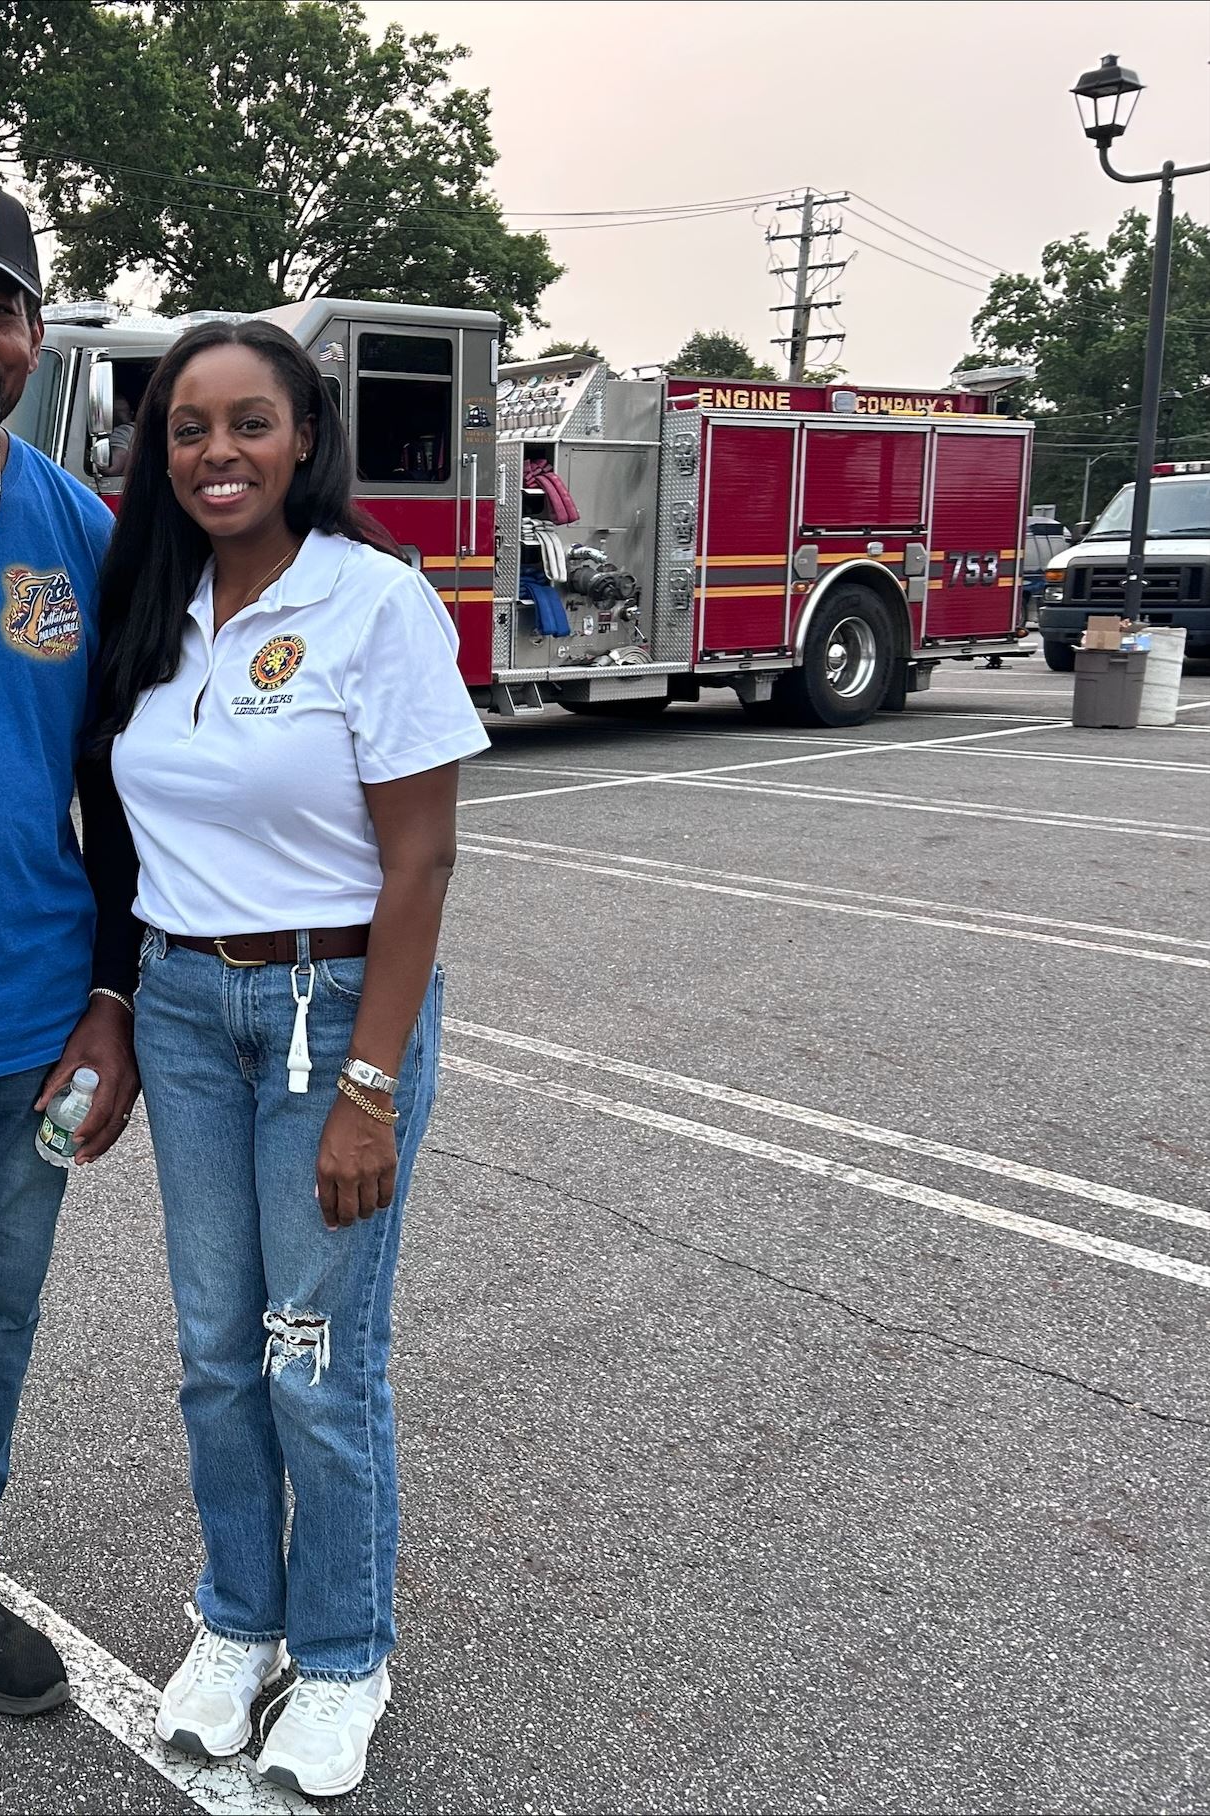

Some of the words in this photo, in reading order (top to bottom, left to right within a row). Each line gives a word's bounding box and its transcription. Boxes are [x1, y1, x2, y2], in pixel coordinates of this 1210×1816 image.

[698, 387, 791, 411] ENGINE
[854, 395, 938, 414] COMPANY
[947, 551, 998, 588] 753
[37, 609, 79, 633] Battalion
[233, 705, 279, 715] LEGISLATOR
